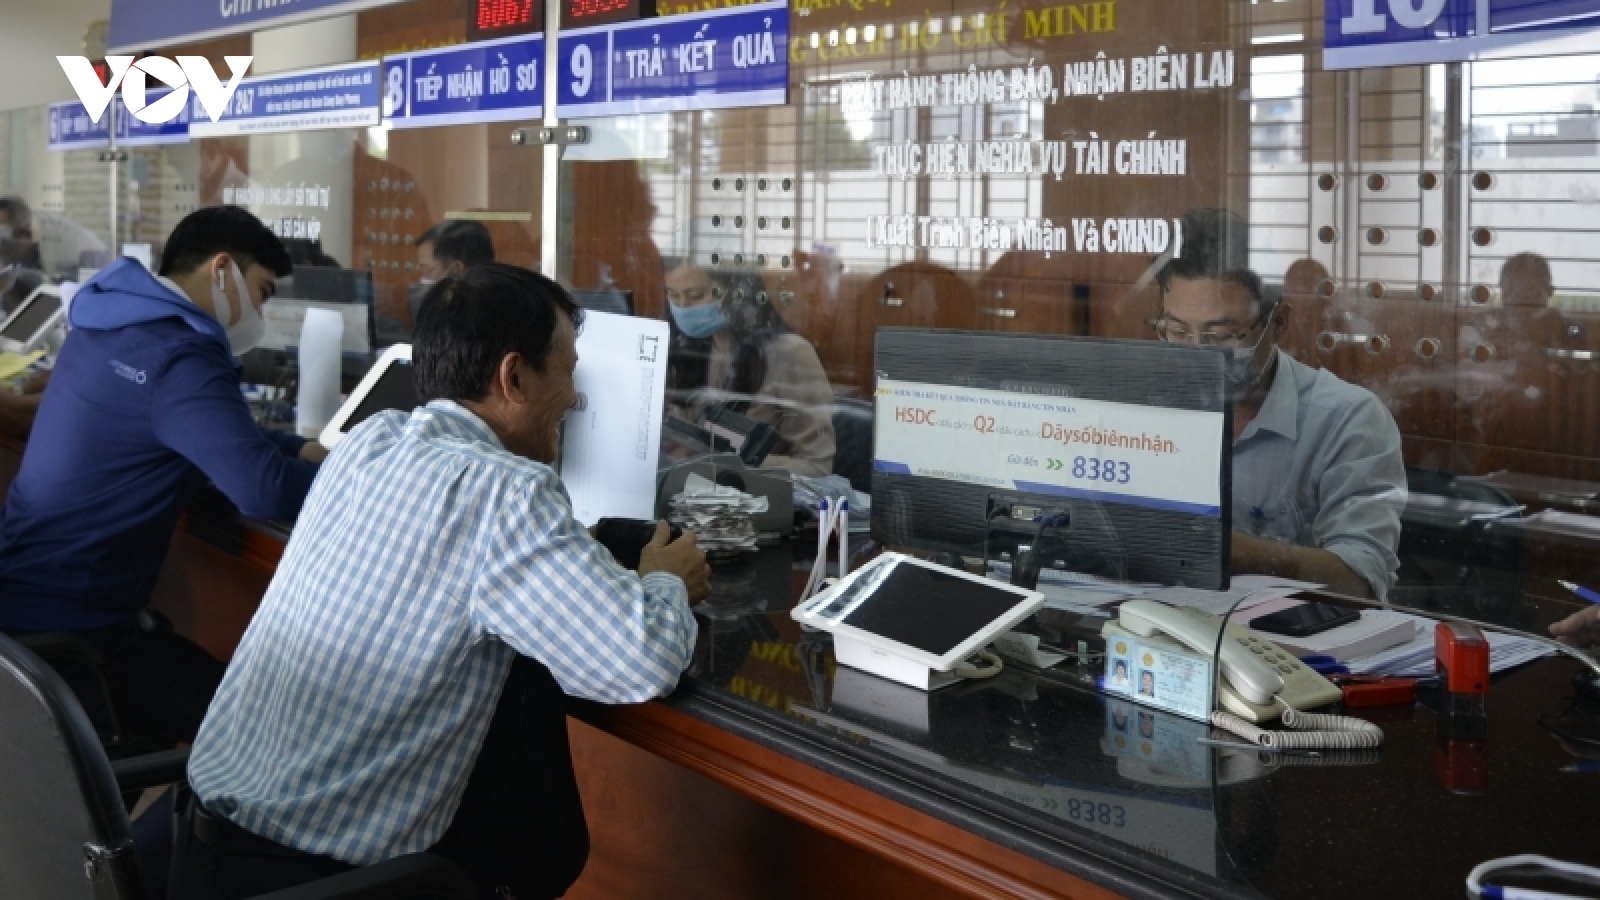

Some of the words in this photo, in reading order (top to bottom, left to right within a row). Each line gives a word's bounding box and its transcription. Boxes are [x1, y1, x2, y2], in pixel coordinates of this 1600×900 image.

[1024, 1, 1117, 40] MINH
[415, 62, 443, 102] TIẾP
[447, 63, 483, 102] NHẬN
[489, 51, 510, 95] HỒ
[516, 58, 538, 92] SƠ
[571, 43, 592, 97] 9
[626, 34, 663, 78] TRẢ
[679, 23, 717, 73] KẾT
[732, 16, 776, 68] QUẢ
[889, 70, 936, 108] HÀNH
[941, 64, 1004, 105] THÔNG
[1064, 50, 1124, 101] NHẬN
[1130, 45, 1188, 91] BIÊN
[1194, 50, 1235, 88] LAI
[876, 138, 921, 181] THỰC
[926, 136, 969, 181] HIỆN
[978, 133, 1033, 174] NGHĨA
[1040, 140, 1066, 182] VỤ
[1073, 131, 1109, 175] TÀI
[1115, 130, 1187, 175] CHÍNH
[1017, 217, 1067, 258] Nhận
[1072, 217, 1098, 253] Và
[895, 405, 936, 426] HSDC
[974, 414, 995, 434] Q2
[1072, 455, 1131, 484] 8383
